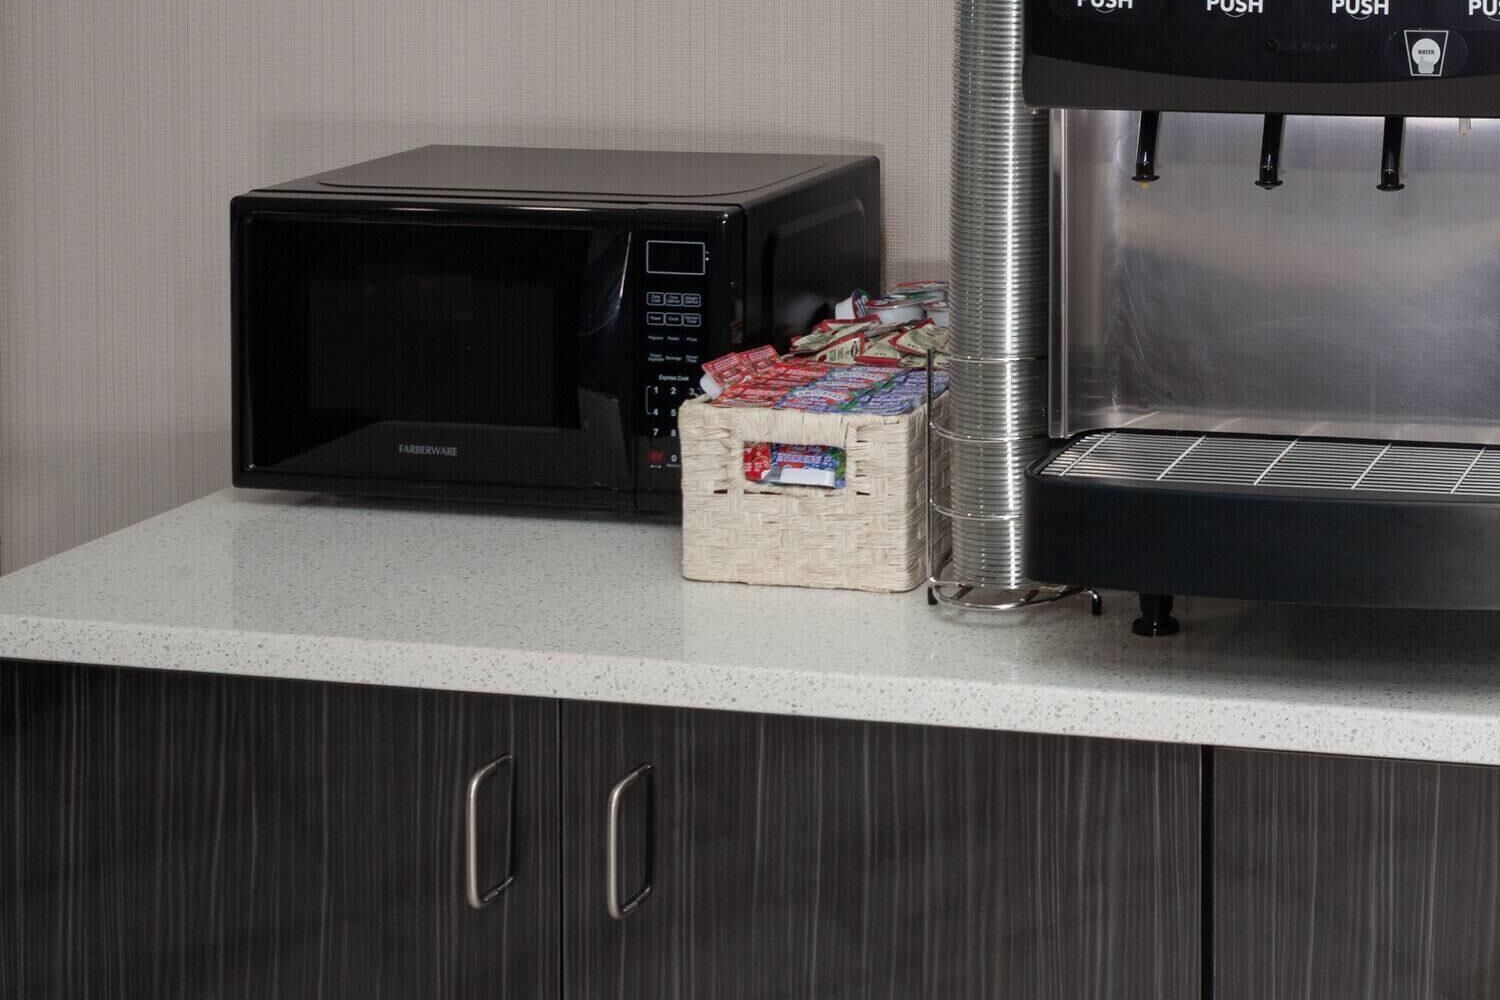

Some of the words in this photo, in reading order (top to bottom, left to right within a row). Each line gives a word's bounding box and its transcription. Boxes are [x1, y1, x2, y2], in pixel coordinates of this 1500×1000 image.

[670, 387, 676, 395] 2
[689, 388, 695, 396] 3
[652, 408, 659, 416] 4
[670, 409, 676, 417] 5
[652, 428, 659, 436] 7
[670, 429, 676, 437] 8
[399, 444, 458, 456] FARBERWARE
